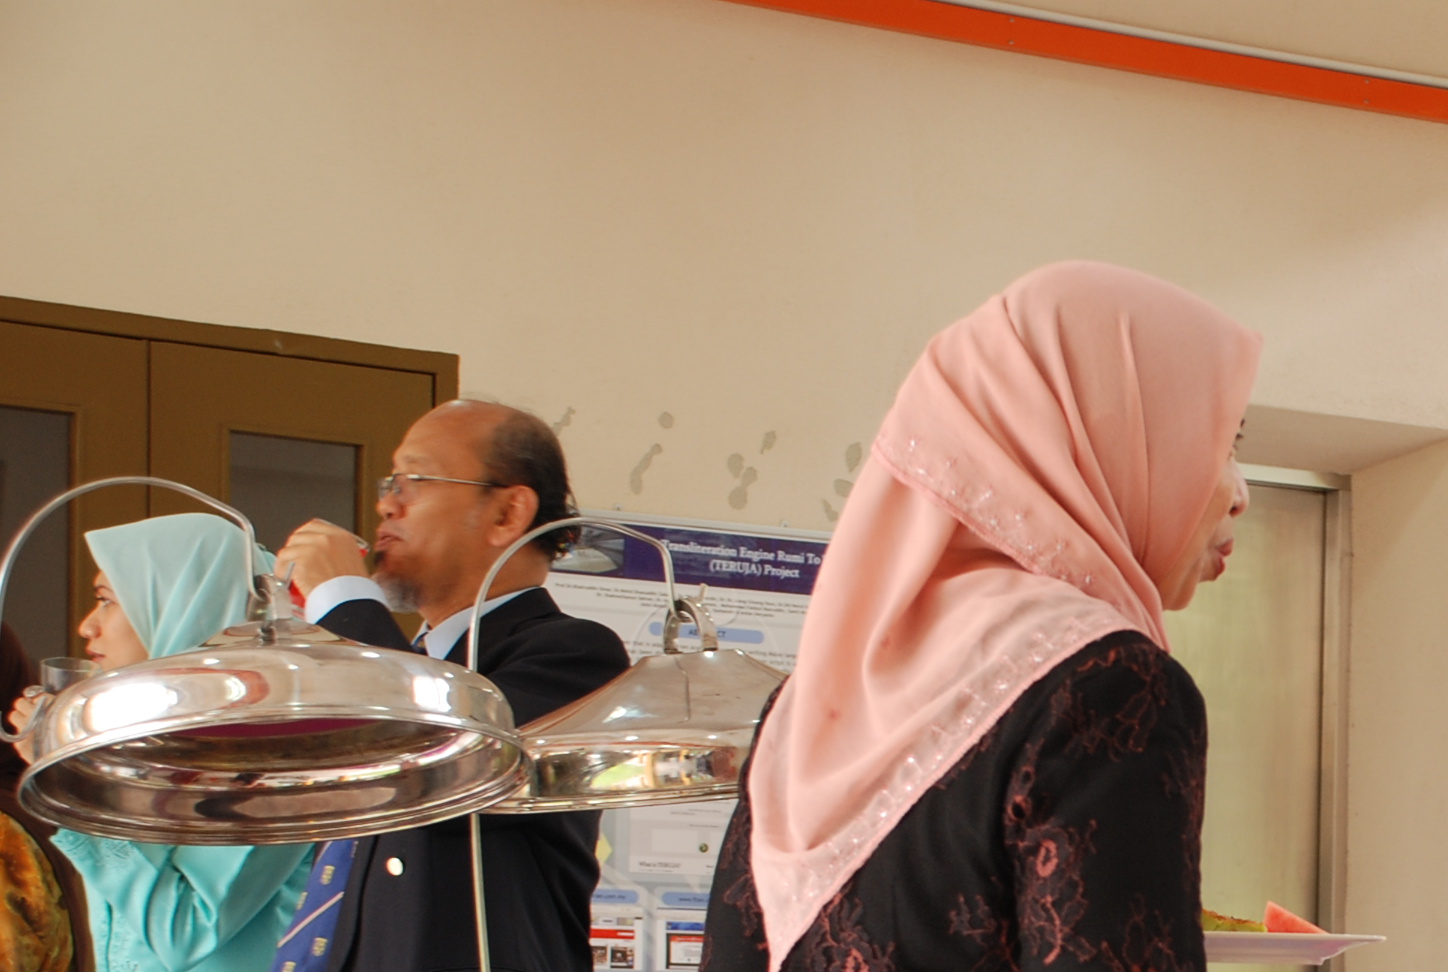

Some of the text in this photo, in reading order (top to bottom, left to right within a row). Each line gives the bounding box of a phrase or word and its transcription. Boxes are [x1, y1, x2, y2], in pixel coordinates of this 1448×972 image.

[739, 546, 775, 562] Engine
[777, 550, 805, 564] Rumi
[807, 553, 821, 565] To
[764, 566, 800, 580] Project
